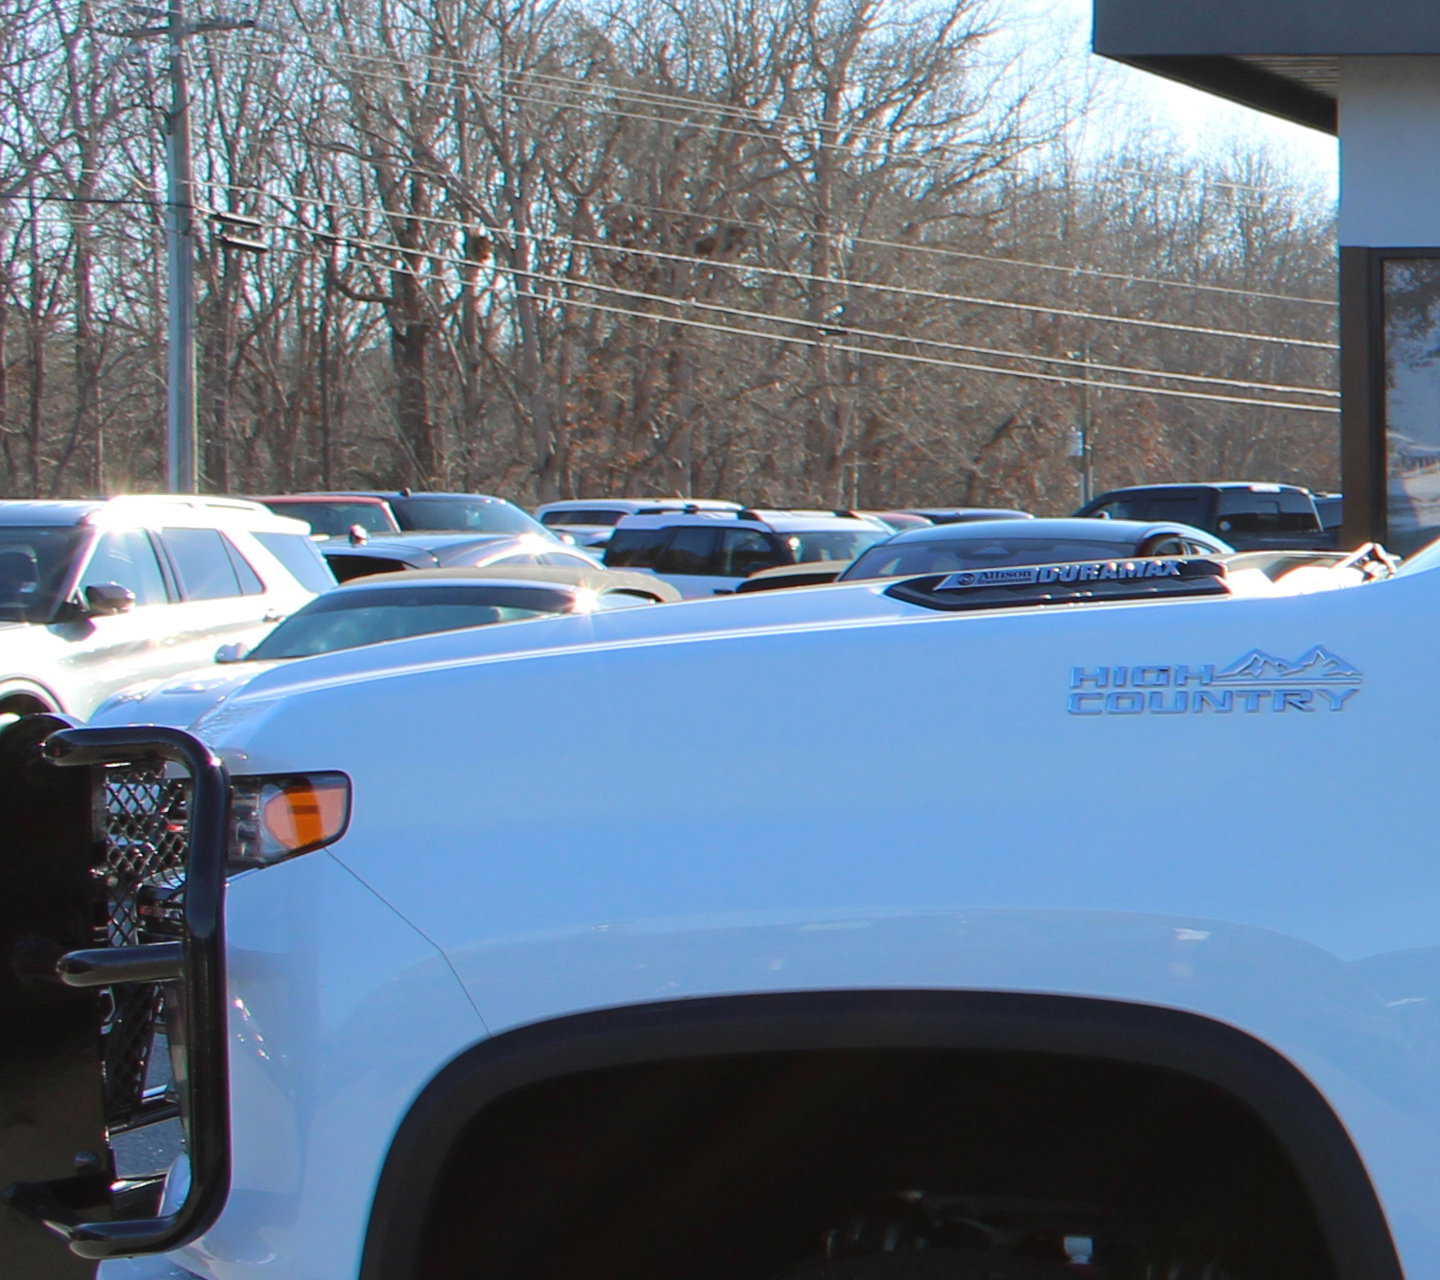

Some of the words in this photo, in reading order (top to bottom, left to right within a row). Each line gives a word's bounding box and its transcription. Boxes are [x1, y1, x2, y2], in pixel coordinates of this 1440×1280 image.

[1038, 560, 1181, 584] DURAMAX
[1069, 664, 1215, 689] HIGH
[1067, 689, 1360, 715] COUNTRY
